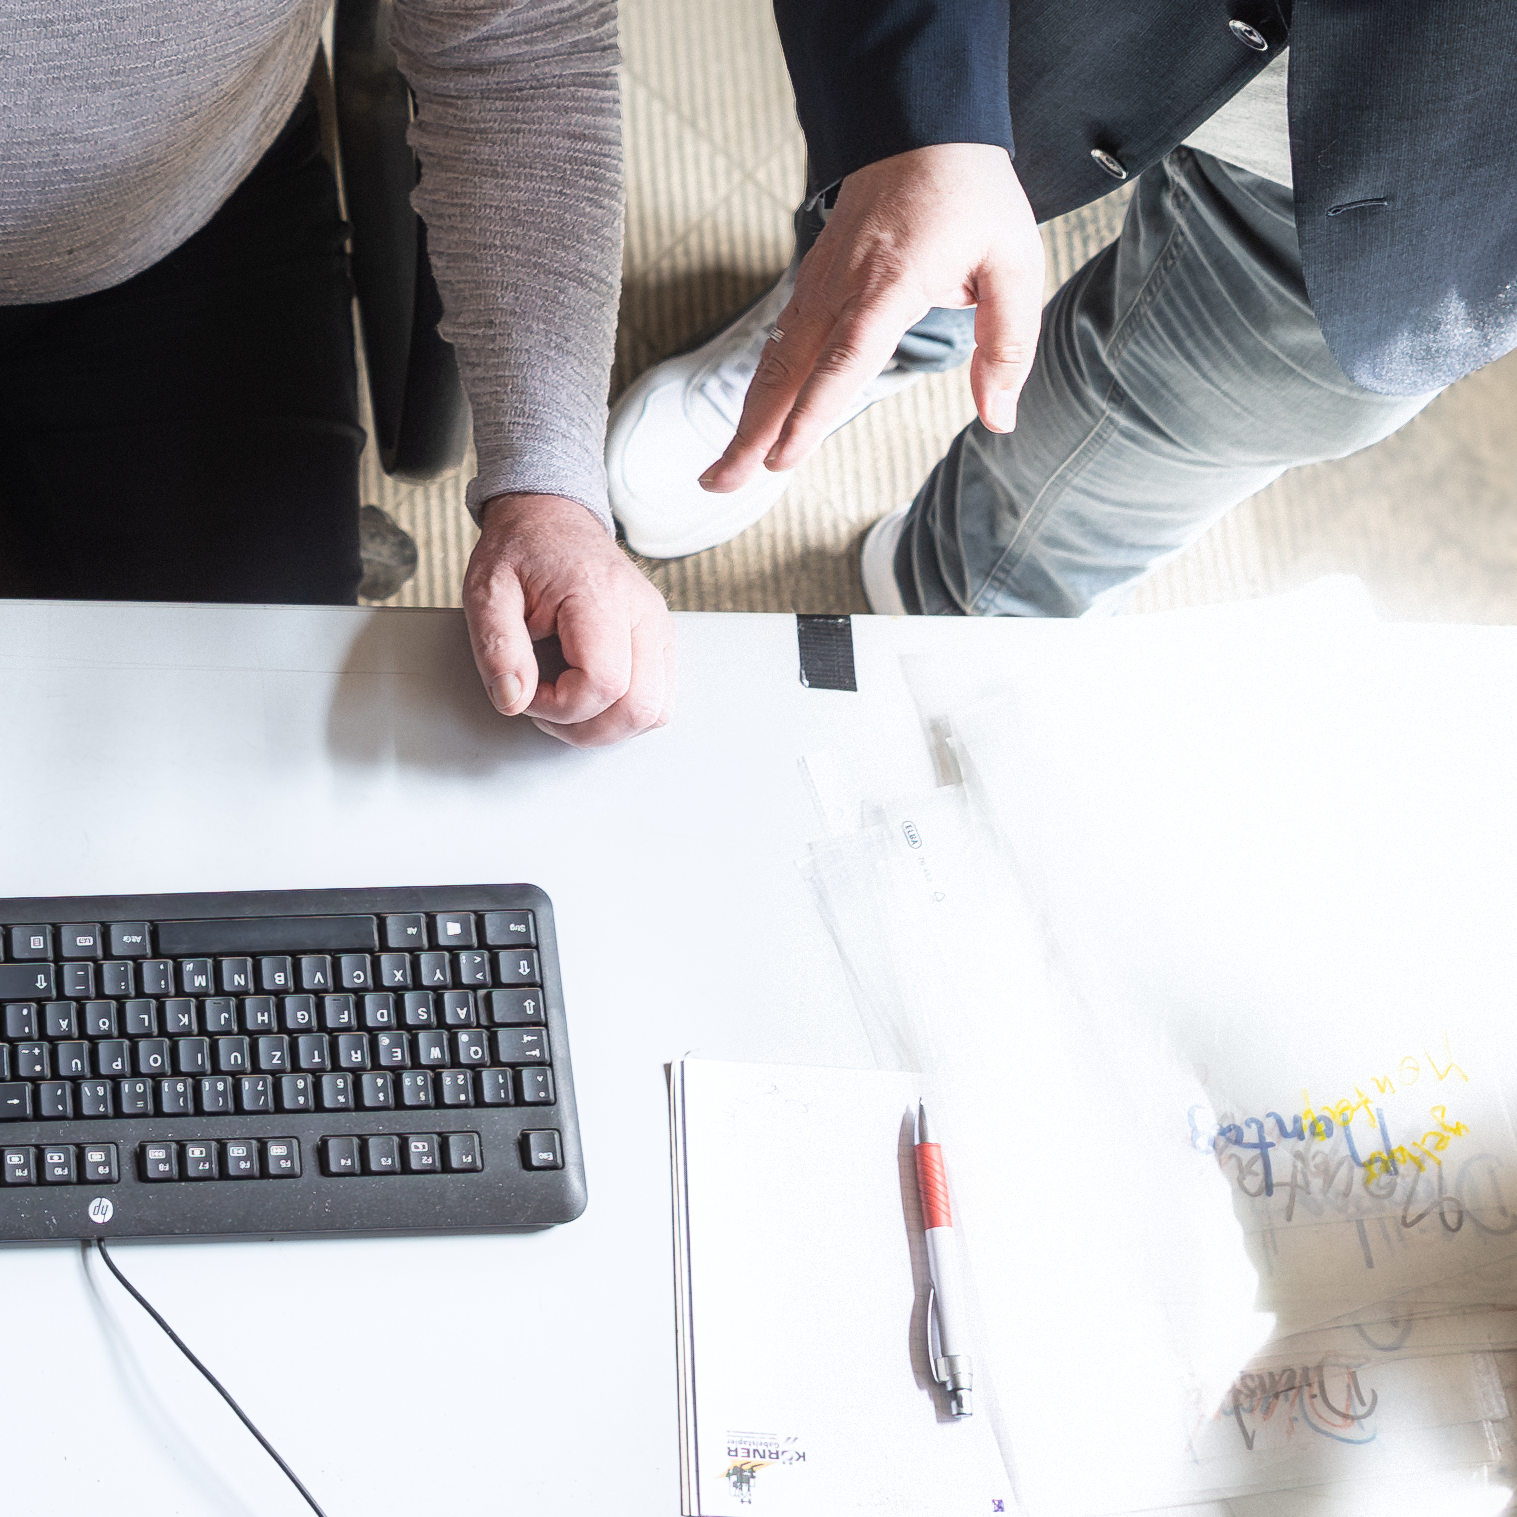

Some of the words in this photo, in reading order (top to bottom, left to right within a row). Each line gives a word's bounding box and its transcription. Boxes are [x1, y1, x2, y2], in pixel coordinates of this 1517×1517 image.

[194, 975, 206, 986] M
[234, 974, 245, 985] N
[275, 973, 284, 984] B
[314, 972, 324, 983] V
[353, 971, 364, 983] C
[394, 970, 403, 981] X
[434, 969, 443, 981] Y
[257, 1012, 268, 1023] H
[297, 1011, 308, 1023] G
[339, 1011, 348, 1022] F
[377, 1010, 388, 1021] D
[418, 1008, 427, 1019] S
[456, 1007, 467, 1019] A
[99, 1019, 109, 1030] Ö
[139, 1015, 148, 1026] L
[178, 1014, 188, 1026] K
[221, 1013, 228, 1025] J
[59, 1019, 68, 1031] Ä
[231, 1052, 241, 1064] U
[271, 1052, 281, 1063] Z
[312, 1051, 321, 1062] T
[351, 1050, 361, 1061] R
[392, 1049, 401, 1060] E
[430, 1047, 441, 1058] W
[470, 1047, 482, 1059] Q
[72, 1059, 81, 1071] Ü
[113, 1058, 121, 1069] P
[150, 1055, 161, 1066] O
[297, 1079, 304, 1089] 6
[337, 1079, 344, 1088] 5
[376, 1078, 383, 1086] 4
[417, 1076, 424, 1085] 3
[457, 1075, 464, 1084] 2
[136, 1084, 144, 1092] 0
[177, 1083, 184, 1092] 9
[217, 1082, 224, 1091] 8
[257, 1081, 264, 1090] 7
[89, 1198, 114, 1224] hp
